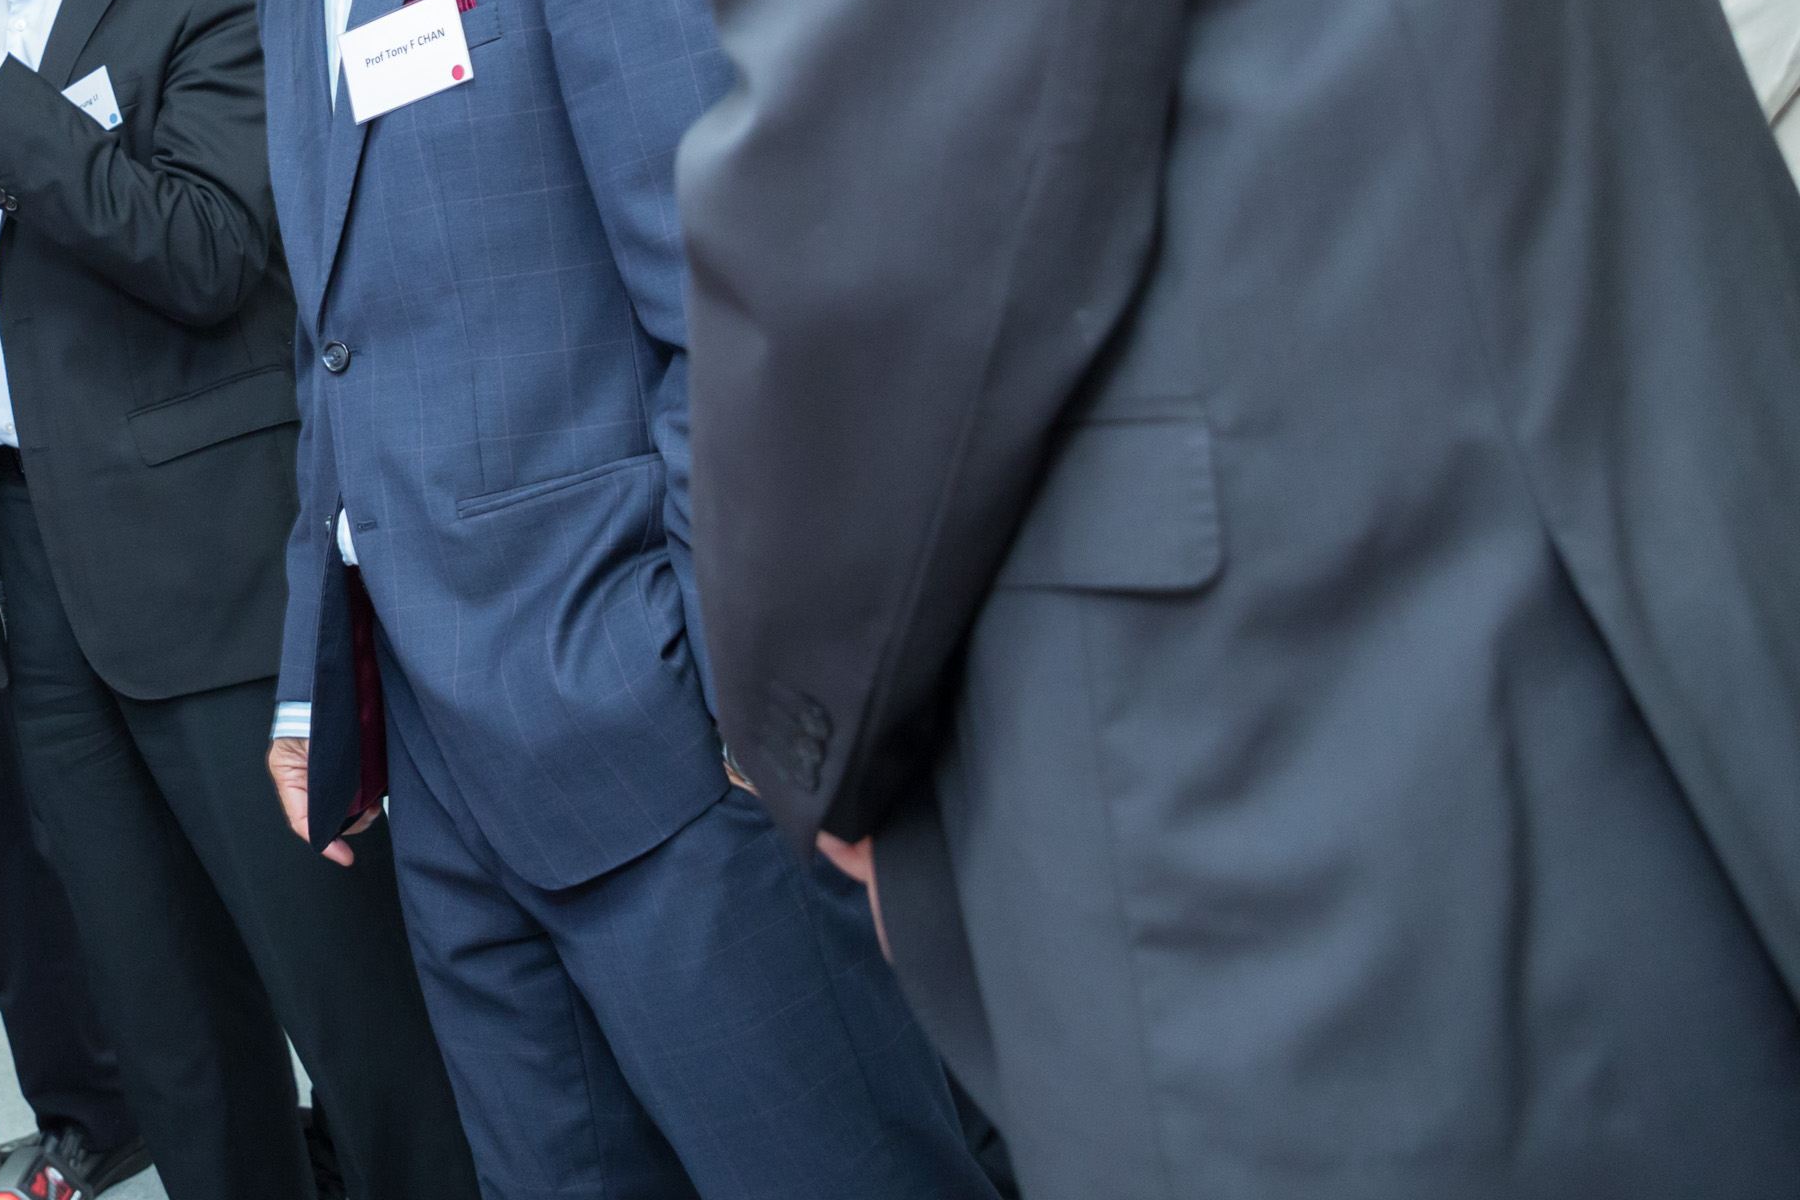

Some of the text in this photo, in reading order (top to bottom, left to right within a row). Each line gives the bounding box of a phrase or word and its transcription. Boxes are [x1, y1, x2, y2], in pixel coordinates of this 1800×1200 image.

[365, 28, 446, 67] Prof Tony F CHAN
